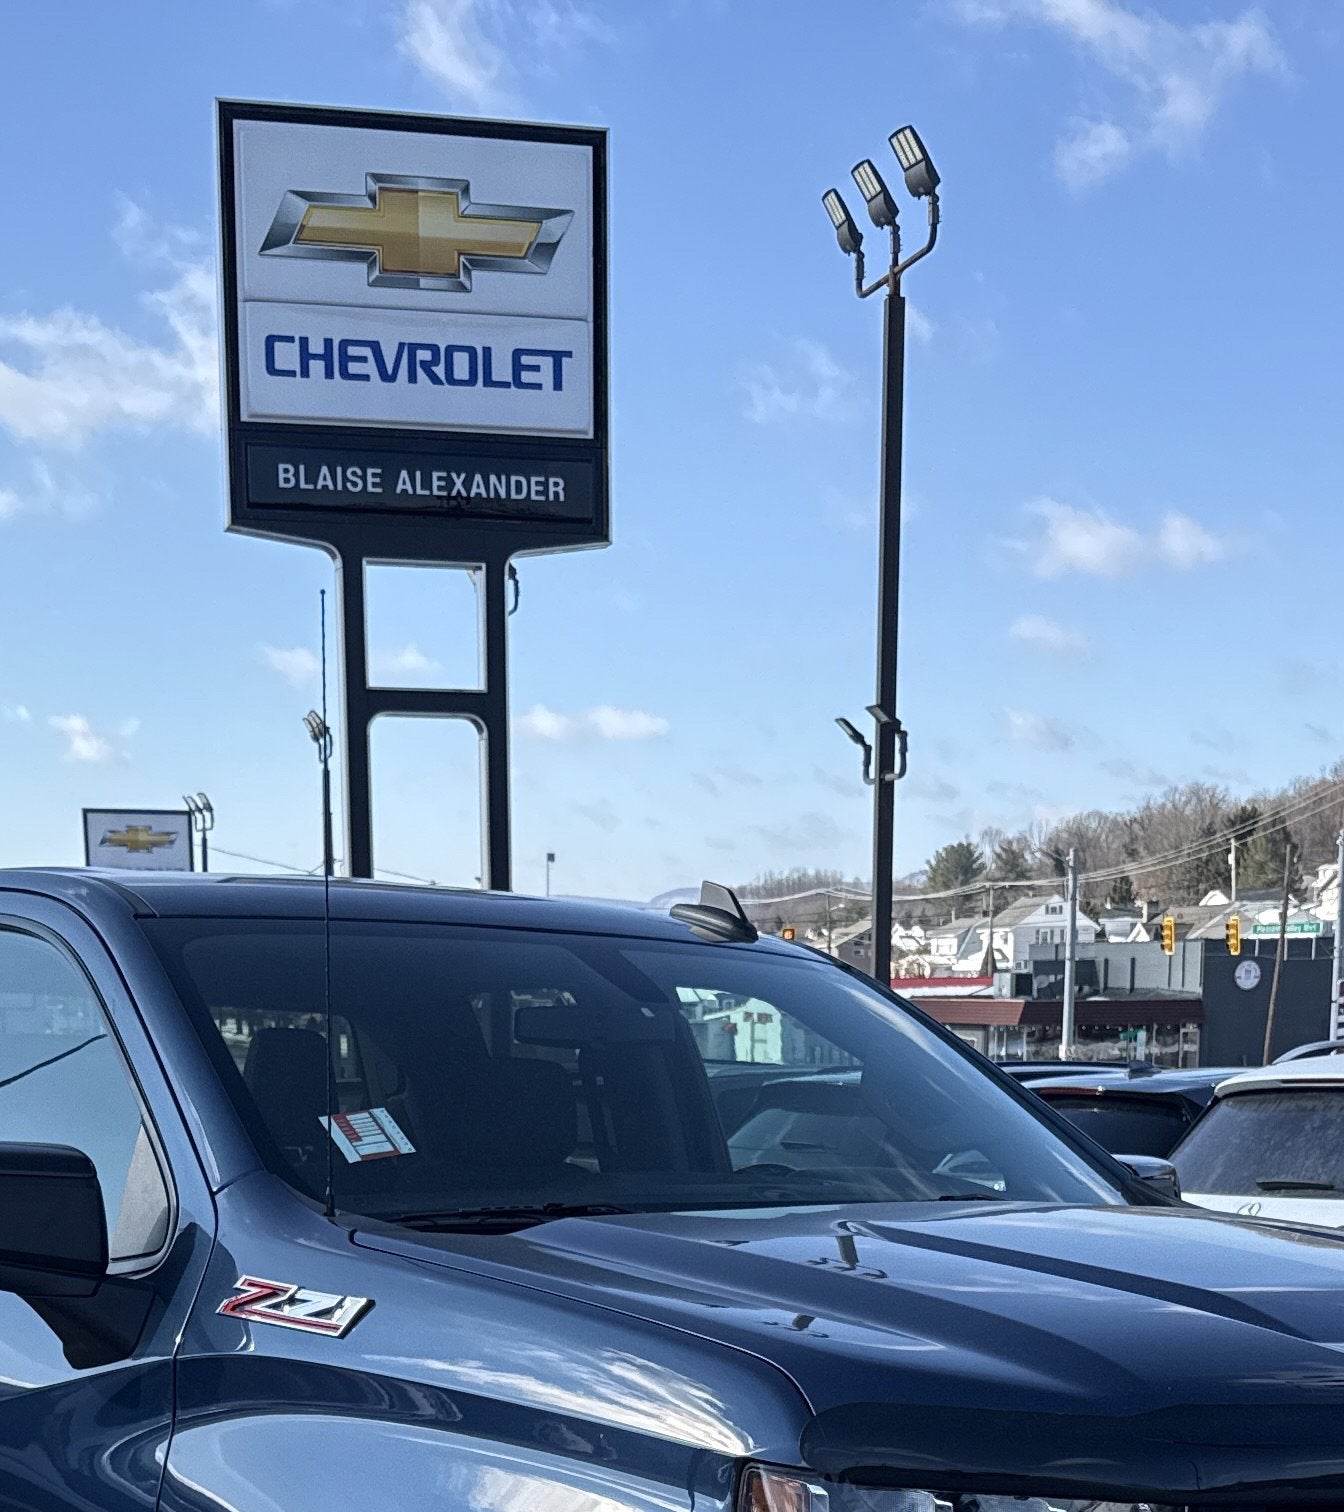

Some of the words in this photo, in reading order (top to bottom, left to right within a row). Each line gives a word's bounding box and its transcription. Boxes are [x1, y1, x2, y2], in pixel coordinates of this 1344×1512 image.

[265, 334, 573, 392] CHEVROLET
[277, 462, 383, 495] BLAISE
[395, 469, 566, 502] ALEXANDER
[215, 1274, 376, 1340] Z71
